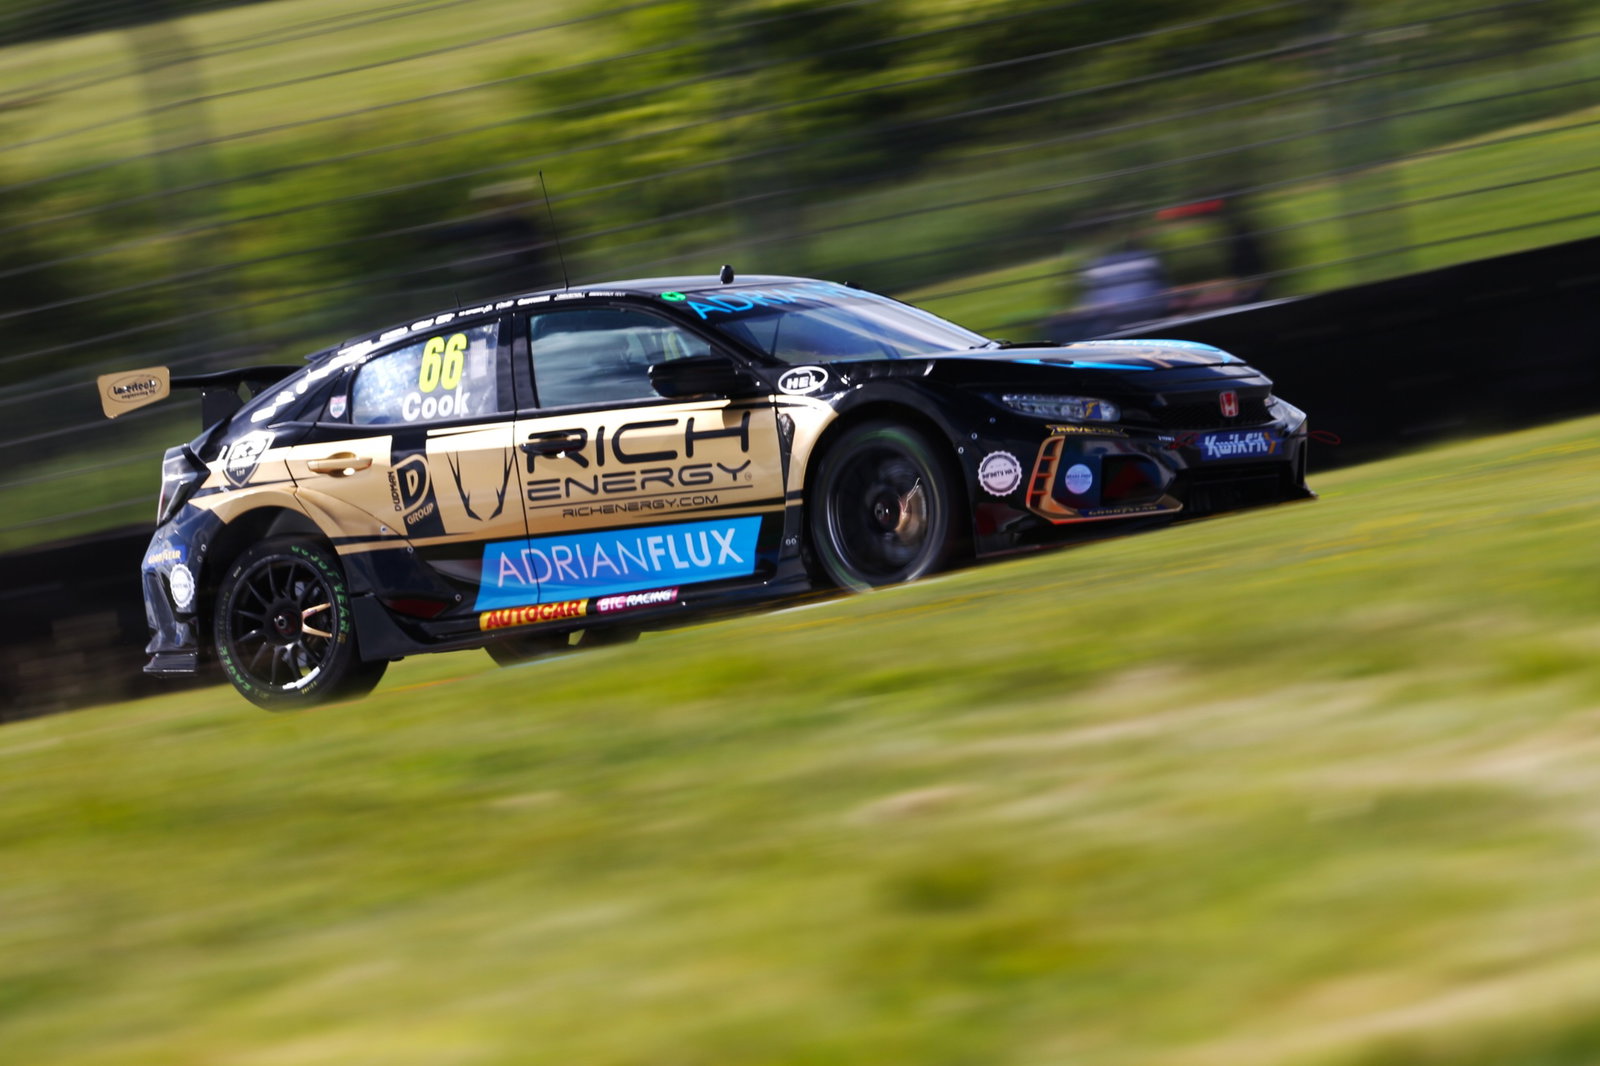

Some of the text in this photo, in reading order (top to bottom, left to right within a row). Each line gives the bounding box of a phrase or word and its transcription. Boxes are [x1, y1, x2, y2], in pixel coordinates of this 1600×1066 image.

[418, 333, 467, 393] 66
[786, 374, 818, 389] HEL
[401, 386, 471, 422] Cook
[527, 411, 751, 475] RICH
[387, 471, 402, 512] DUDMAN
[527, 460, 752, 501] ENERGY
[406, 502, 434, 525] GROUP
[562, 494, 719, 519] RICHENERGY.COM
[487, 601, 580, 628] AUTOCAR
[600, 590, 671, 612] BTC RACING
